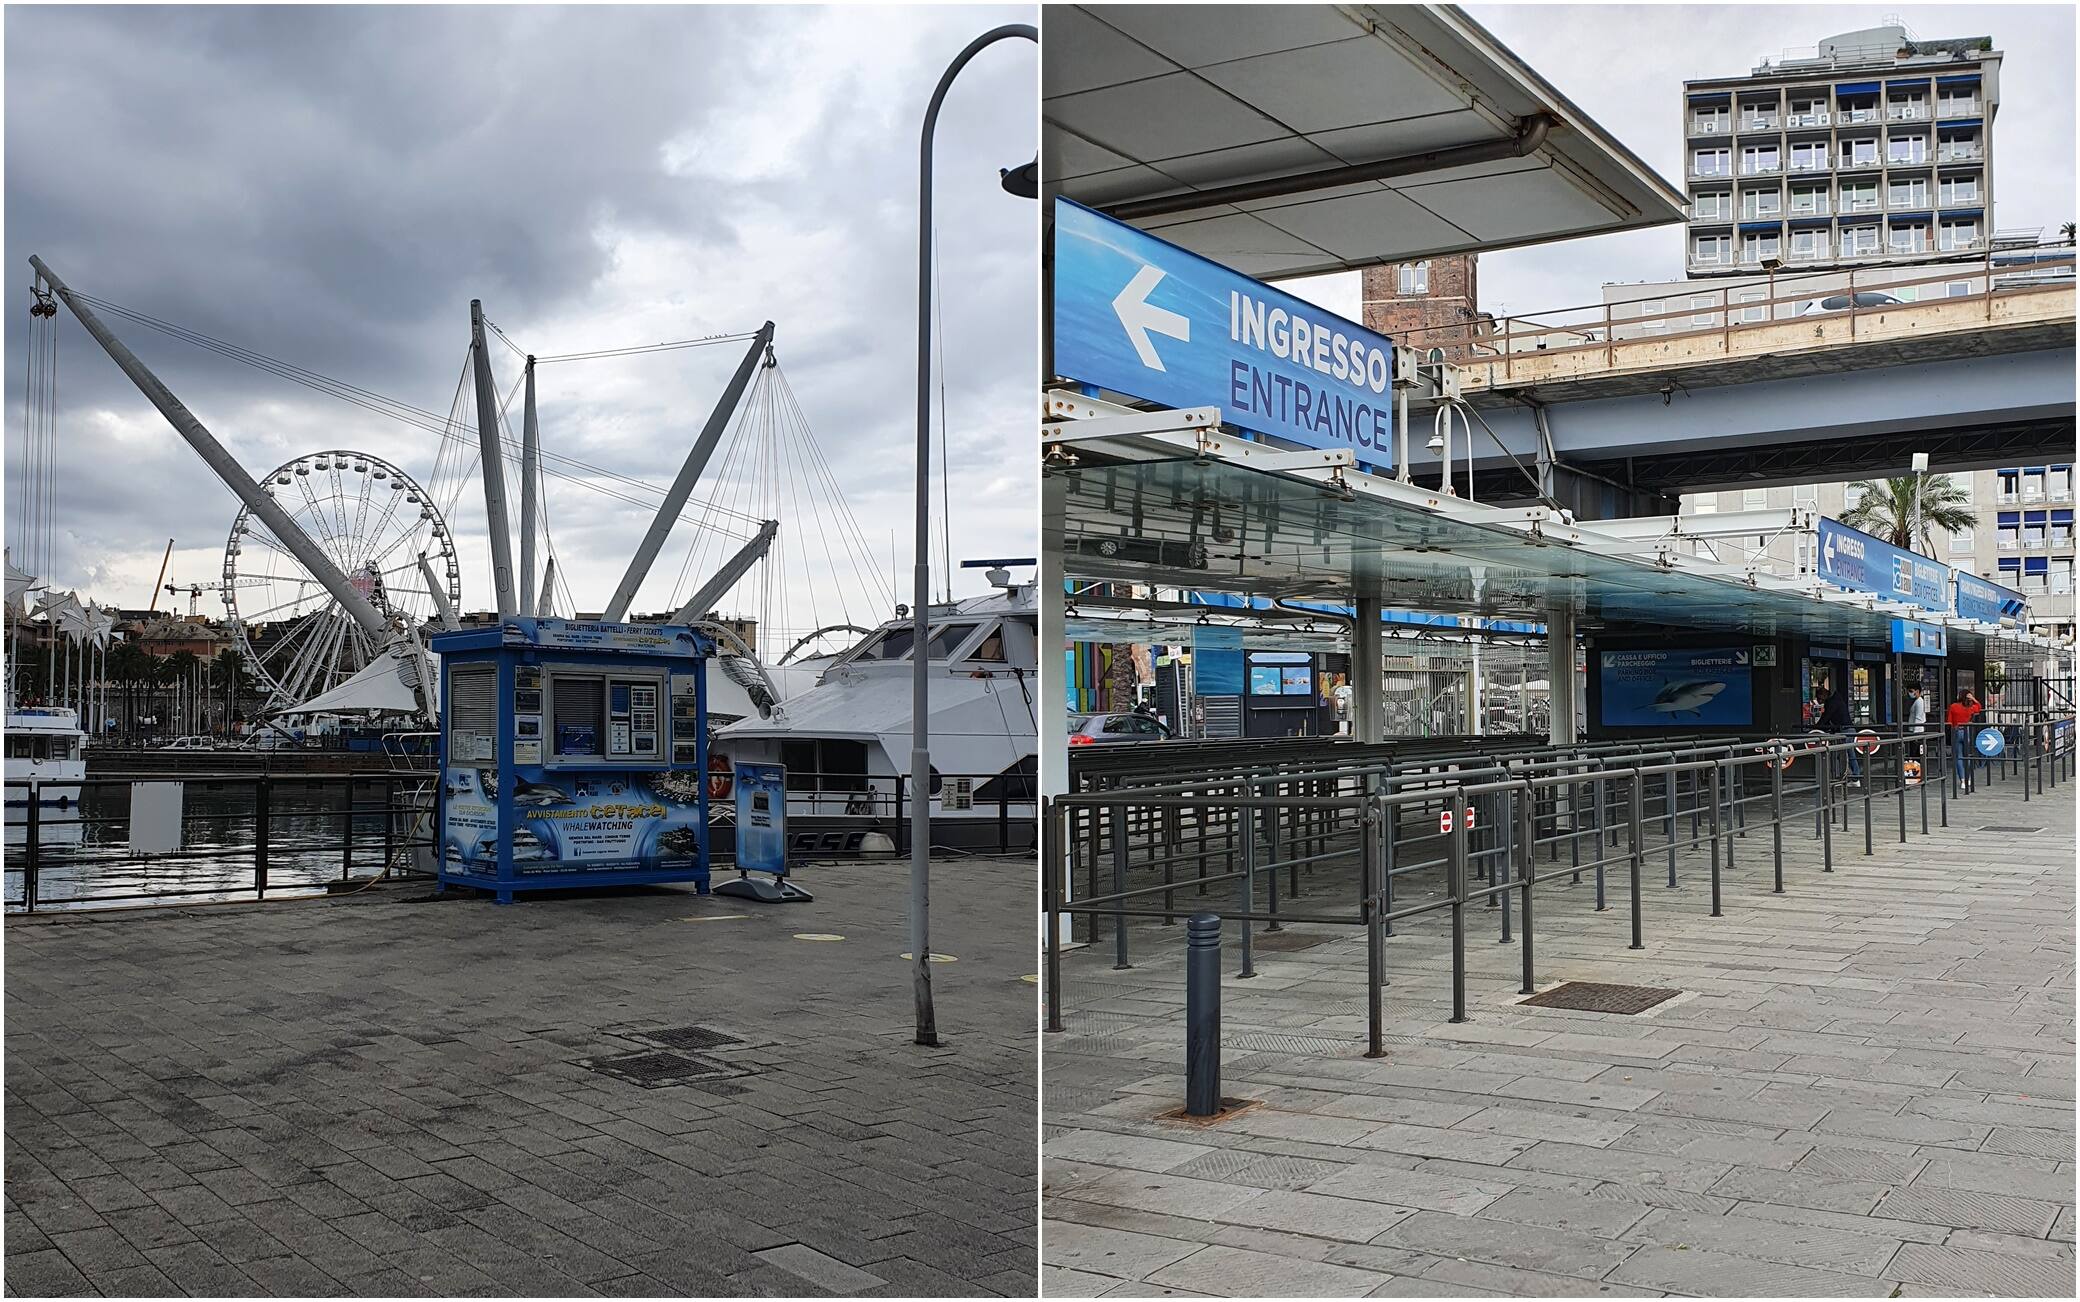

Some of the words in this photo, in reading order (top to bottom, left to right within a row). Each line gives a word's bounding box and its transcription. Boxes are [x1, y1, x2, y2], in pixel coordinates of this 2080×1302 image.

[1231, 290, 1388, 394] INGRESSO
[1231, 359, 1388, 453] ENTRANCE
[1836, 533, 1865, 561] INGRESSO
[1836, 559, 1865, 584] ENTRANCE
[565, 623, 600, 633] BIGLIETTERIA
[600, 625, 624, 634] BATTELLI
[626, 627, 642, 635] FERRY
[643, 628, 663, 636] TICKETS
[1691, 658, 1732, 666] BIGLIETTERIE
[527, 810, 588, 820] AVVISTAMENTO
[563, 821, 633, 832] WHALEWATCHING
